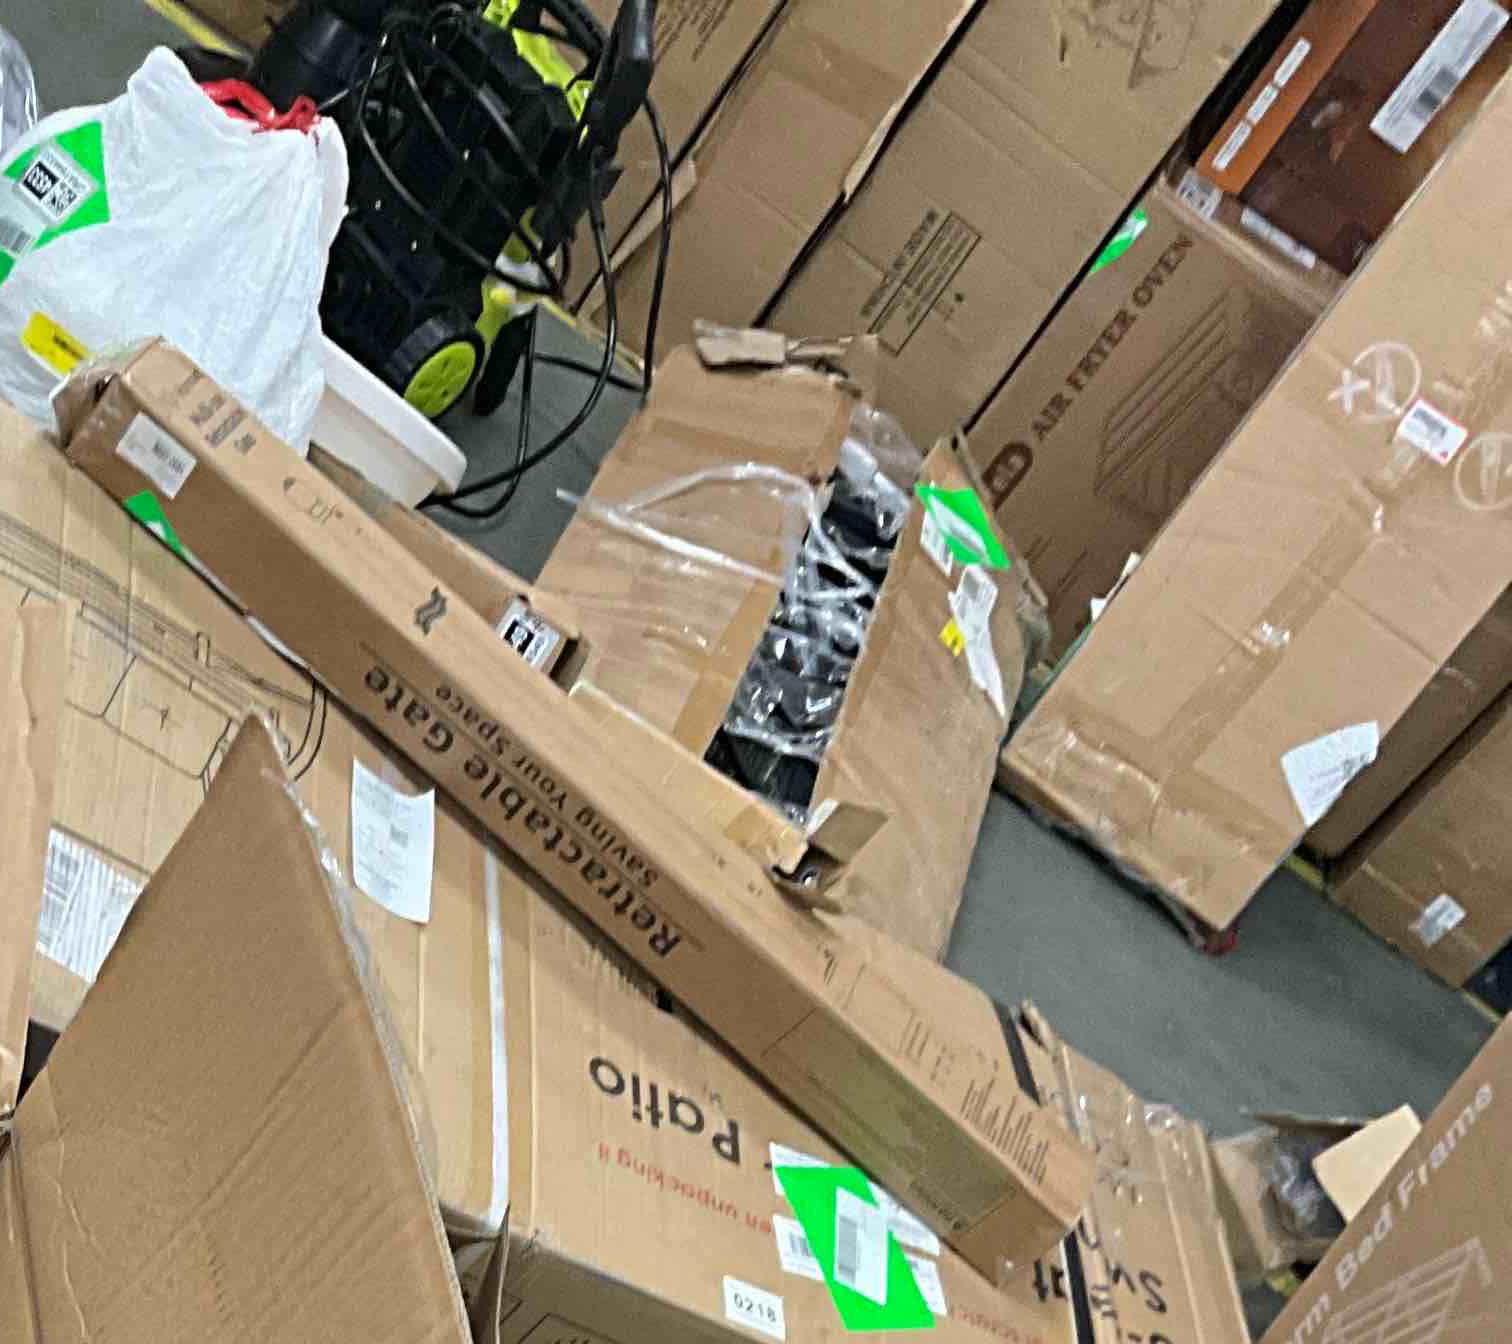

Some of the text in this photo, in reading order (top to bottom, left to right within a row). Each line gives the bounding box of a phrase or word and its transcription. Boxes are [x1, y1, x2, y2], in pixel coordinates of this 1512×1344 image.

[1032, 234, 1193, 442] AIR FRYER OVEN
[365, 665, 454, 752] Gate
[435, 686, 659, 888] Saving Your Space
[464, 752, 680, 956] Retractable
[588, 1056, 742, 1165] Patio
[1336, 1202, 1393, 1291] Bed
[1397, 1082, 1492, 1211] Frame
